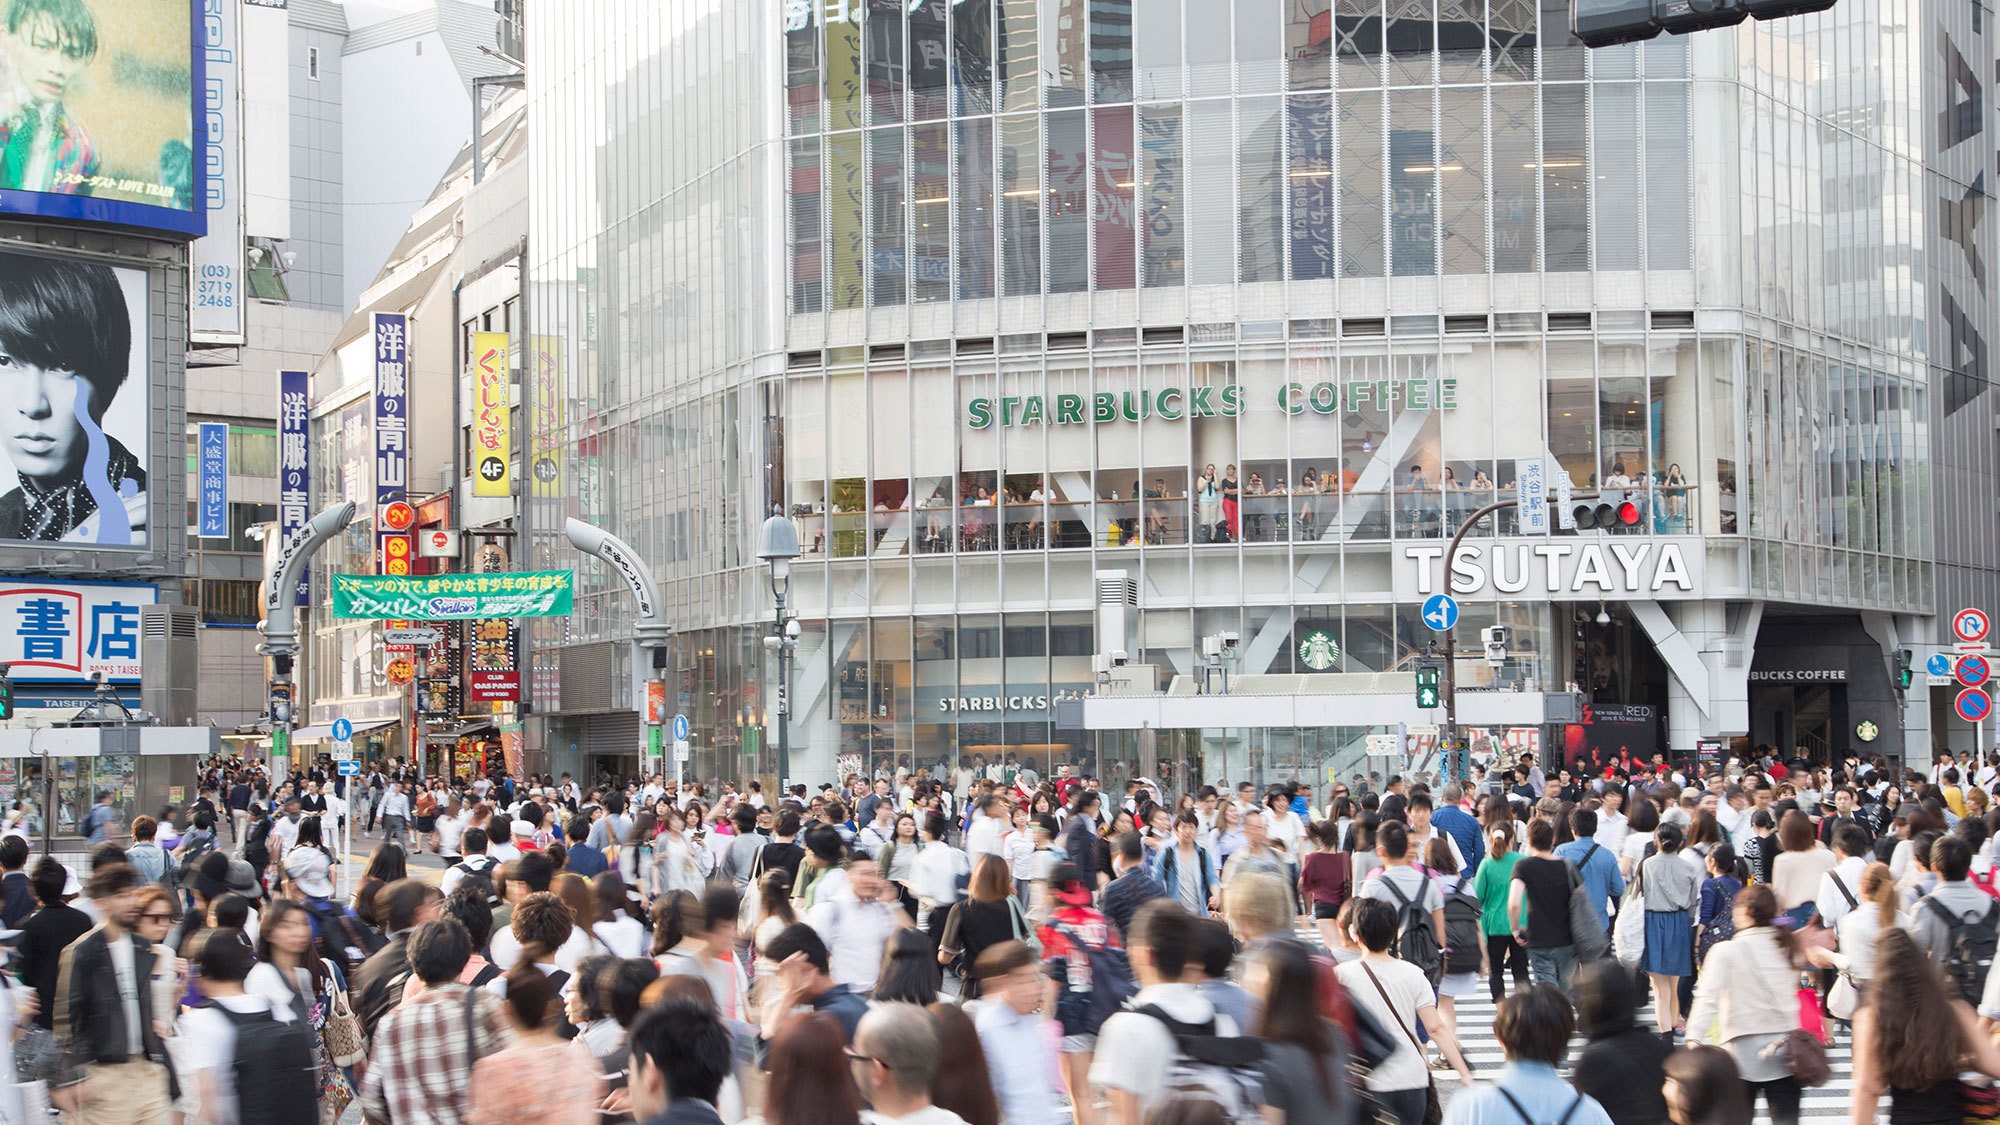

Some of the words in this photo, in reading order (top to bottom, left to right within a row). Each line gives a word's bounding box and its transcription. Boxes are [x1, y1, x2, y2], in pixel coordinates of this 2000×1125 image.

[117, 178, 145, 193] LOVE
[198, 281, 232, 293] 3719
[200, 264, 231, 279] (03)
[198, 294, 233, 307] 2468
[376, 323, 407, 487] 洋服の青山
[967, 383, 1247, 430] STARBUCKS
[1276, 378, 1458, 416] COFFEE
[205, 430, 222, 531] 大盛堂商事ビル
[481, 461, 503, 477] 4F
[1528, 464, 1543, 527] 渋谷駅前
[269, 529, 310, 606] 渋谷センター街
[604, 544, 650, 614] 渋谷センター街
[1405, 543, 1694, 594] TSUTAYA
[16, 598, 139, 660] 書店
[1748, 670, 1795, 681] BUCKS
[1796, 670, 1846, 680] COFFEE
[939, 696, 1047, 712] STARBUCKS
